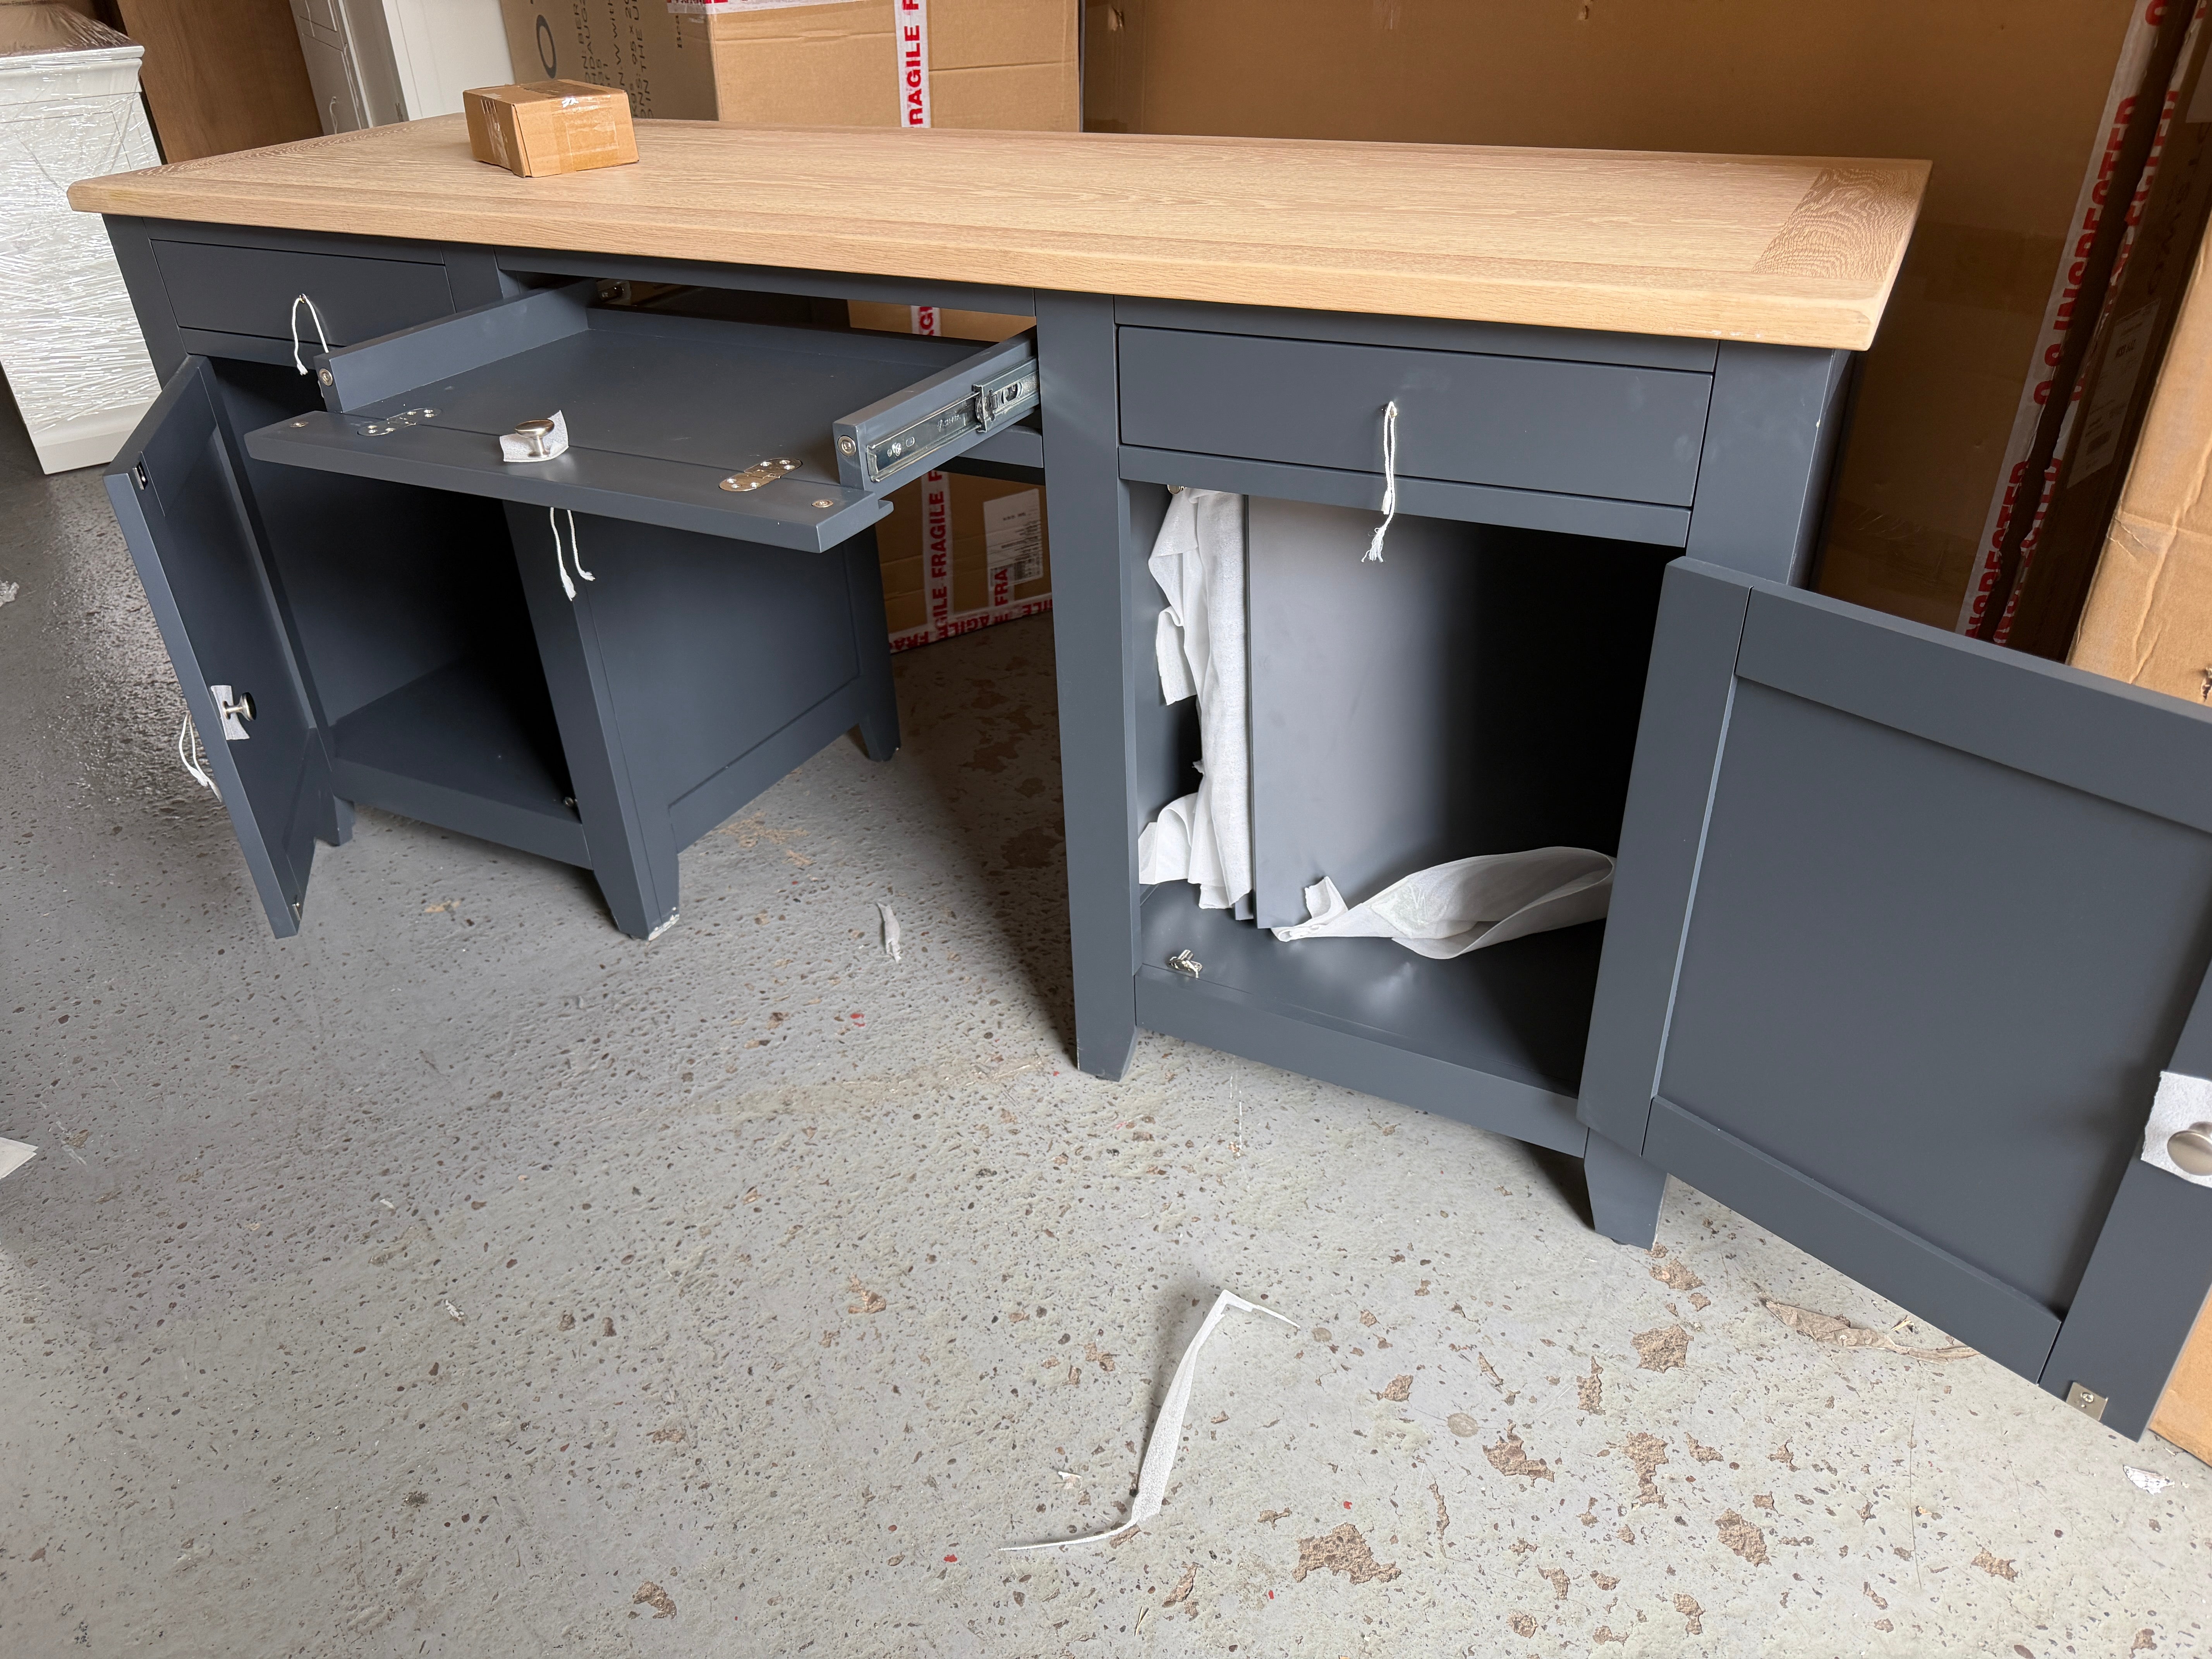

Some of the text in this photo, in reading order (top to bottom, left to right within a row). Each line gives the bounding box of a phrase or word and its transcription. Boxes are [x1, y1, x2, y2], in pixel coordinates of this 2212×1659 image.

[635, 28, 647, 73] THE
[903, 25, 924, 128] RAGILE
[929, 491, 947, 578] FRAGILE
